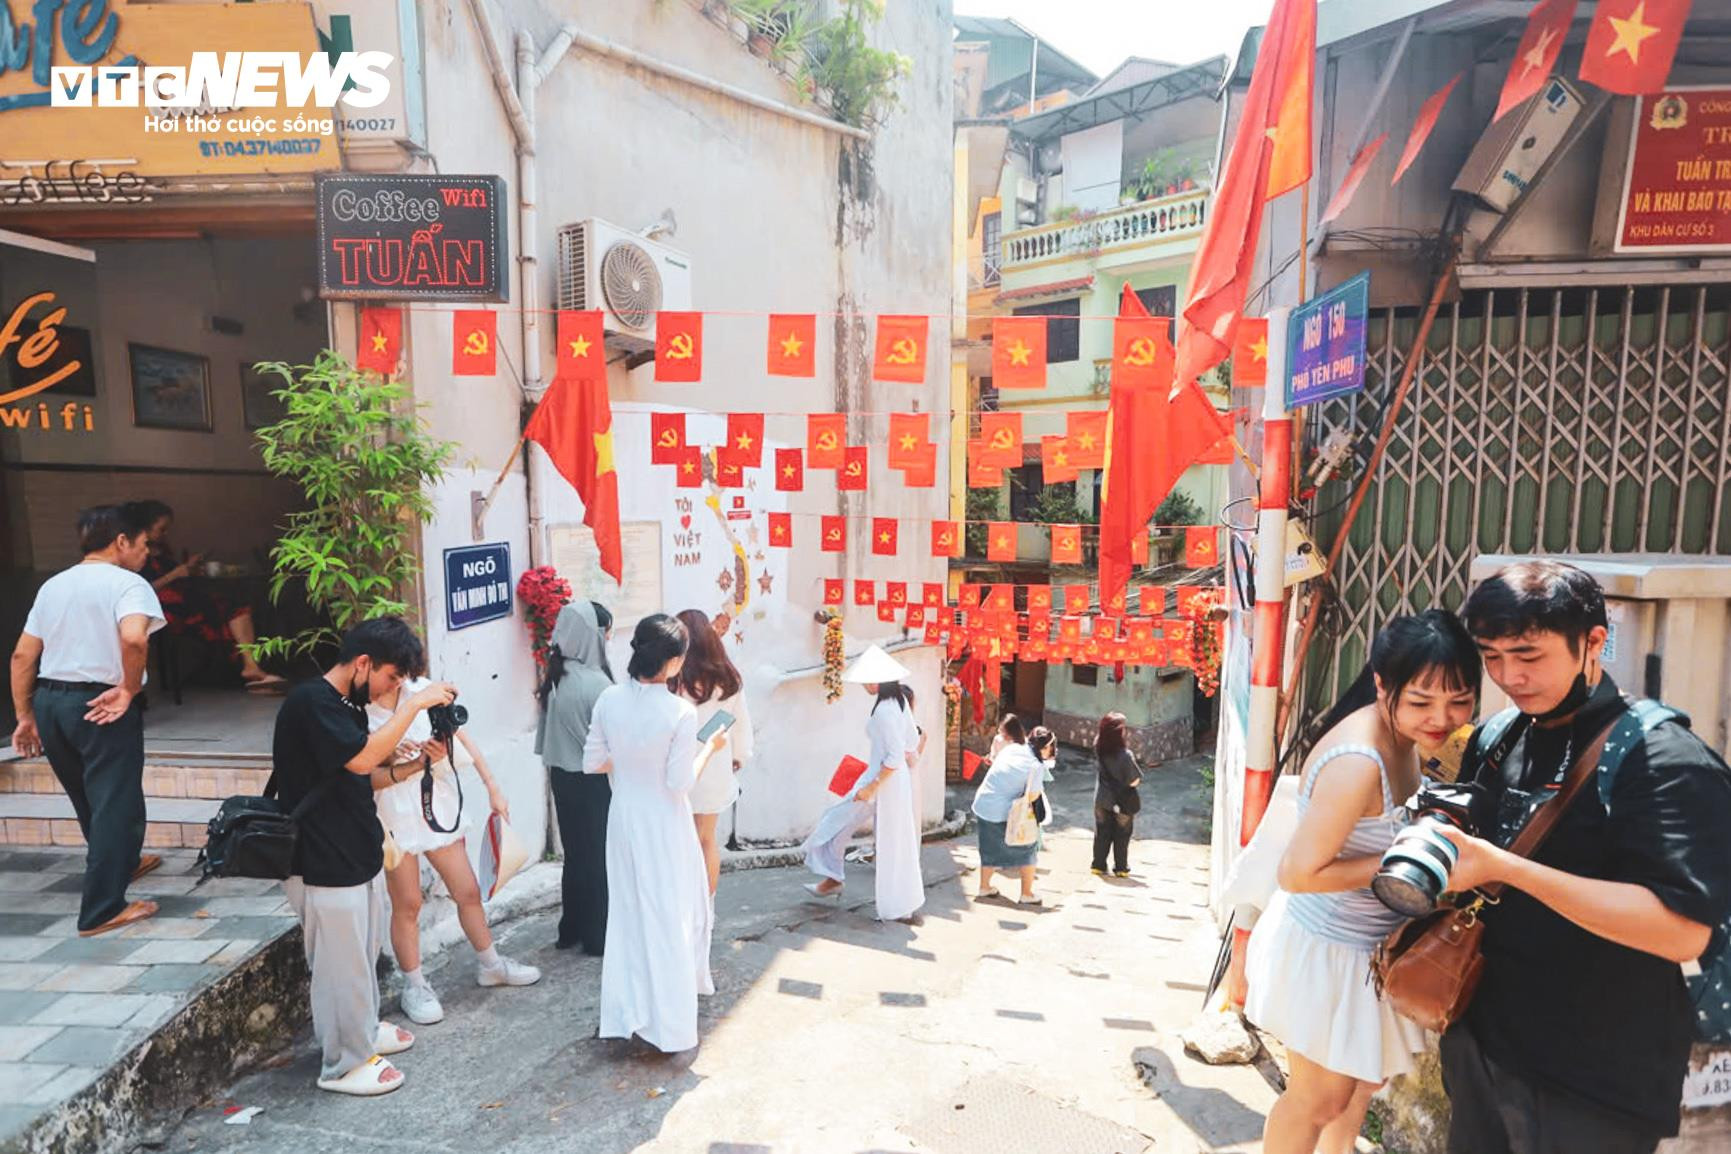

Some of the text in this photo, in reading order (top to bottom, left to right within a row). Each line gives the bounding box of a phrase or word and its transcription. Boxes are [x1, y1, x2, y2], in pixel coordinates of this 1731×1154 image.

[332, 188, 487, 222] Coffee Wifi
[1653, 191, 1686, 212] KHAI
[332, 222, 485, 286] TUẤN
[0, 402, 94, 432] wifi
[462, 555, 496, 578] NGÕ
[674, 552, 701, 566] NAM
